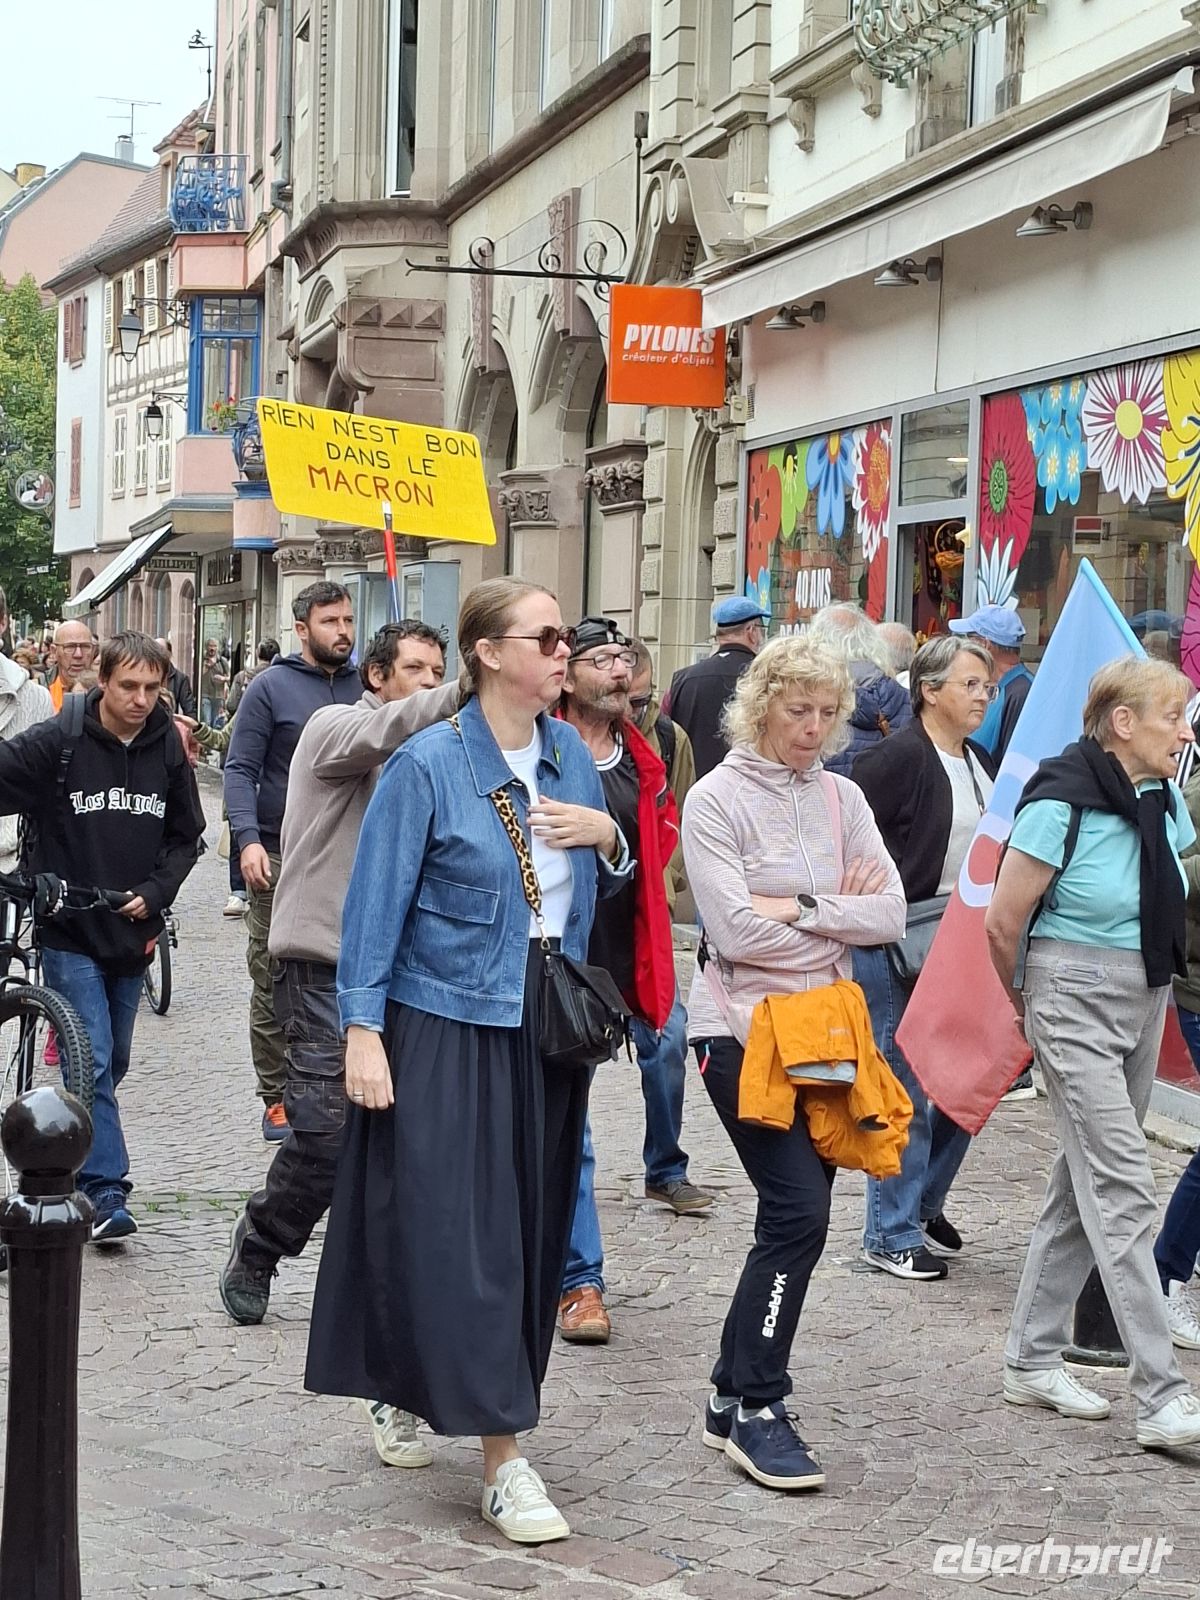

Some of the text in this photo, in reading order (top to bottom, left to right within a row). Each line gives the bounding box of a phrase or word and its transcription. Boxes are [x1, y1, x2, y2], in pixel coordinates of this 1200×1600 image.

[622, 351, 668, 364] créateur
[623, 324, 716, 353] PYLONES
[262, 402, 316, 431] RIEN
[425, 433, 477, 459] BON
[326, 441, 438, 478] DANS LE
[307, 463, 434, 508] MACRON
[795, 567, 832, 610] 40 ANS
[69, 787, 167, 819] Los Angeles
[761, 1271, 788, 1339] KARPOS
